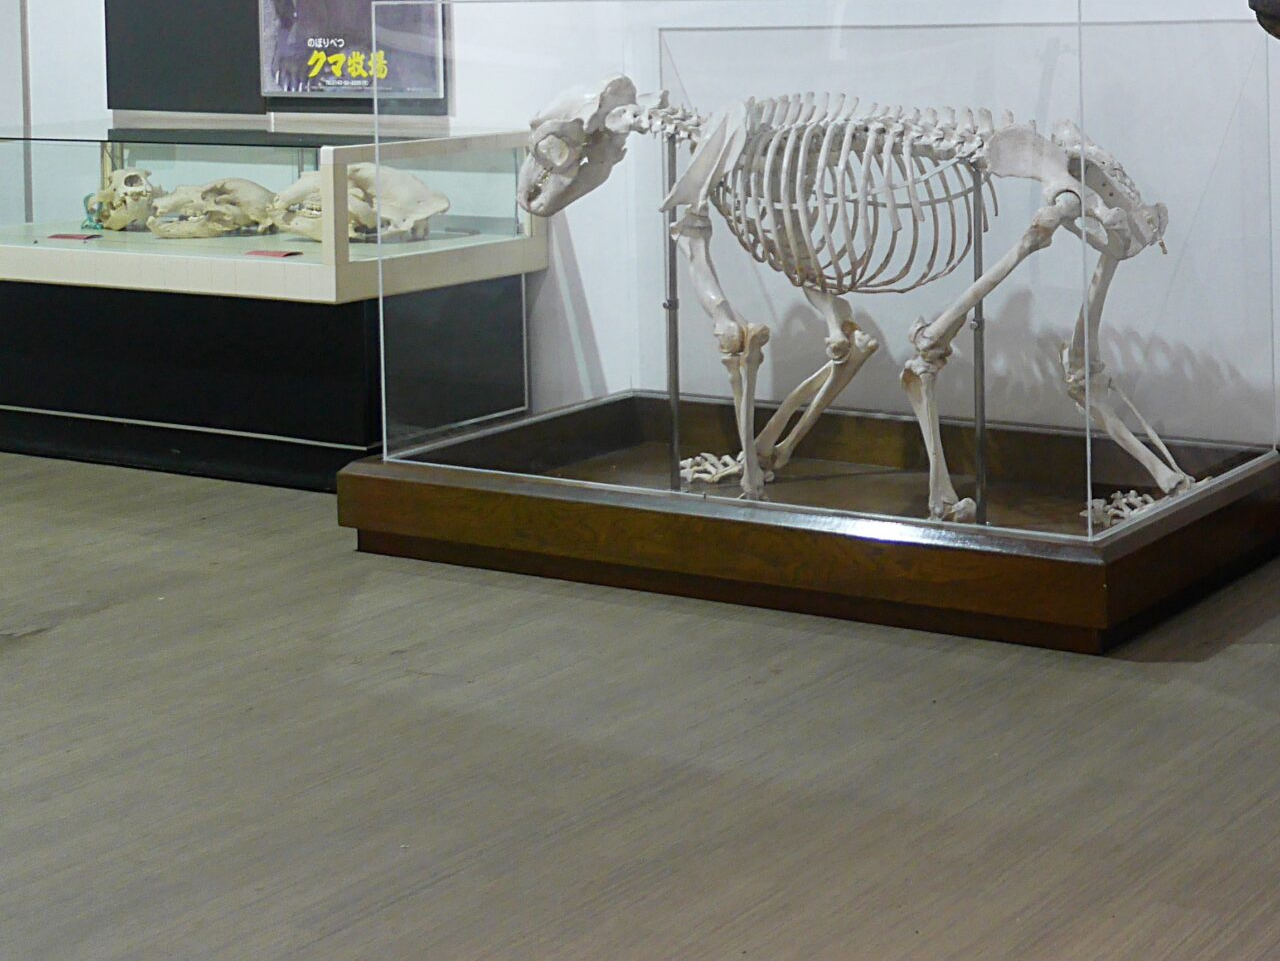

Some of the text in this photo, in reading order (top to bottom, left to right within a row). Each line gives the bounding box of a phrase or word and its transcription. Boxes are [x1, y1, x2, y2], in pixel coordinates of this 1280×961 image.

[307, 37, 345, 48] のぼりべつ
[307, 49, 389, 79] クマ牧場
